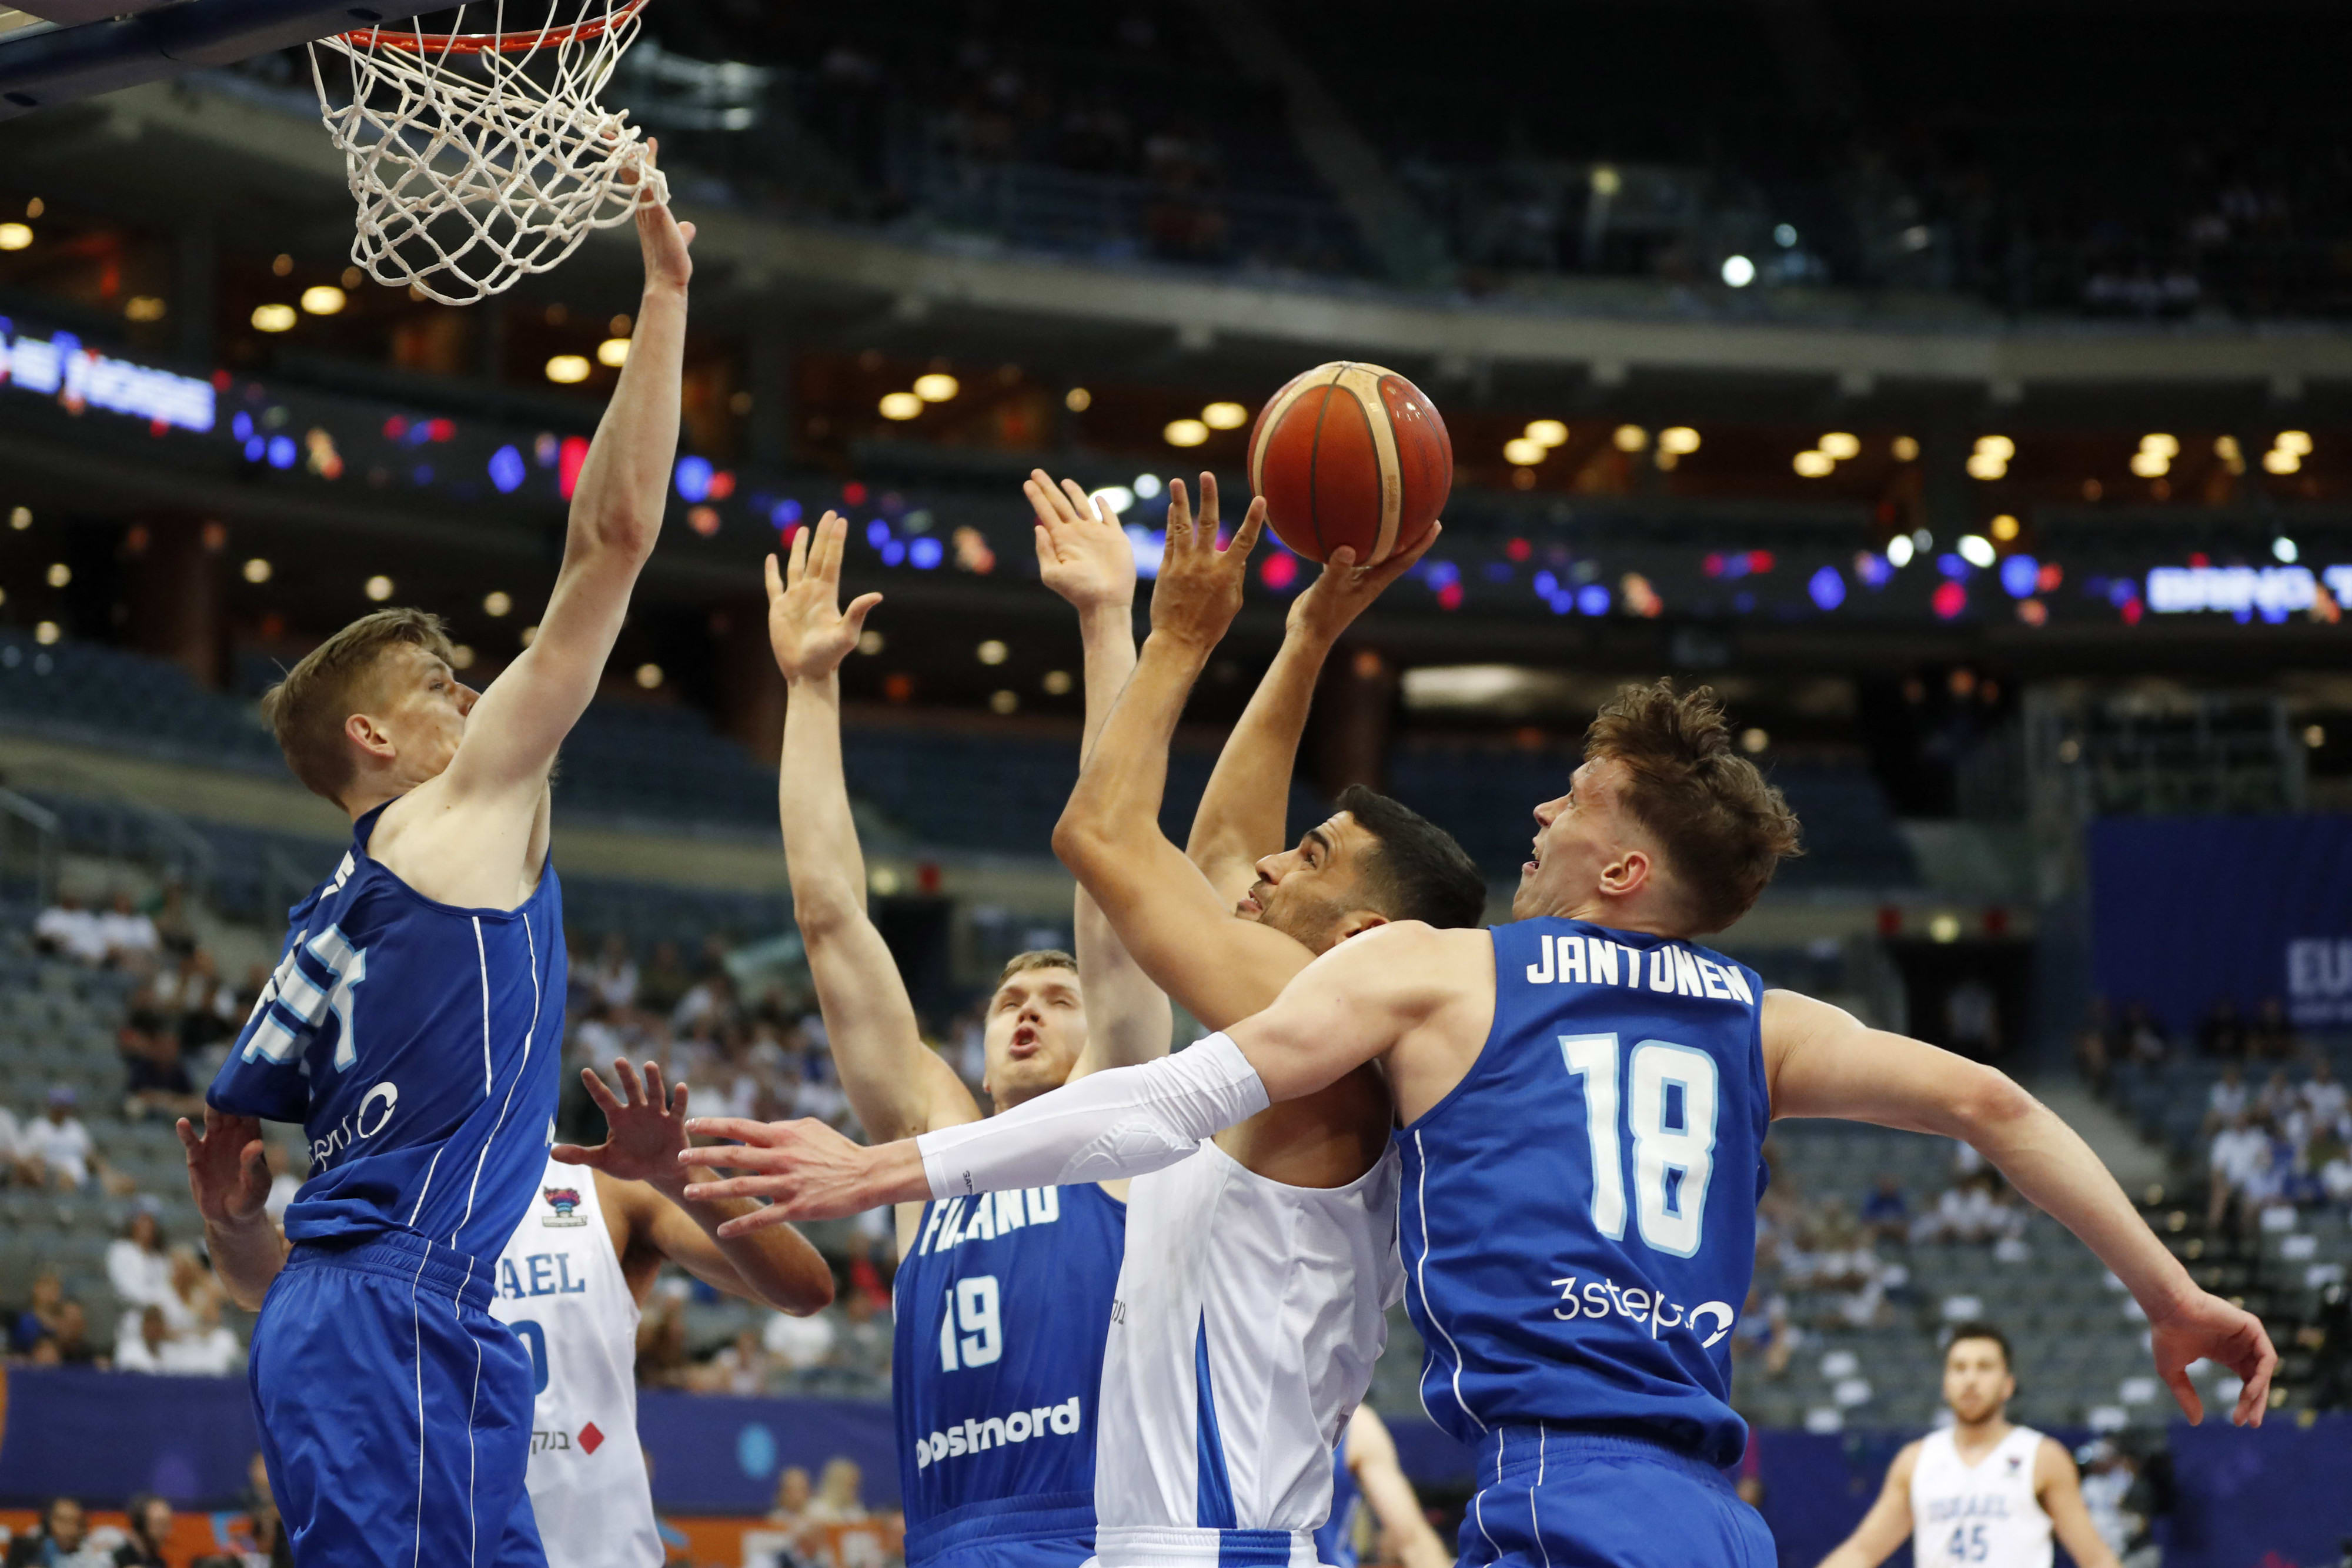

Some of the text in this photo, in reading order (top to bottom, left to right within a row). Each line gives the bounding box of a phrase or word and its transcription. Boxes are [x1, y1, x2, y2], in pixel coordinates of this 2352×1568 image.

[1526, 935, 1754, 1005] JANTONEN
[1558, 1032, 1719, 1259] 18
[495, 1252, 586, 1300] AEL
[940, 1275, 1003, 1373] 19
[531, 1431, 570, 1455] בנק
[916, 1396, 1080, 1477] postnord
[1949, 1524, 1989, 1563] 45
